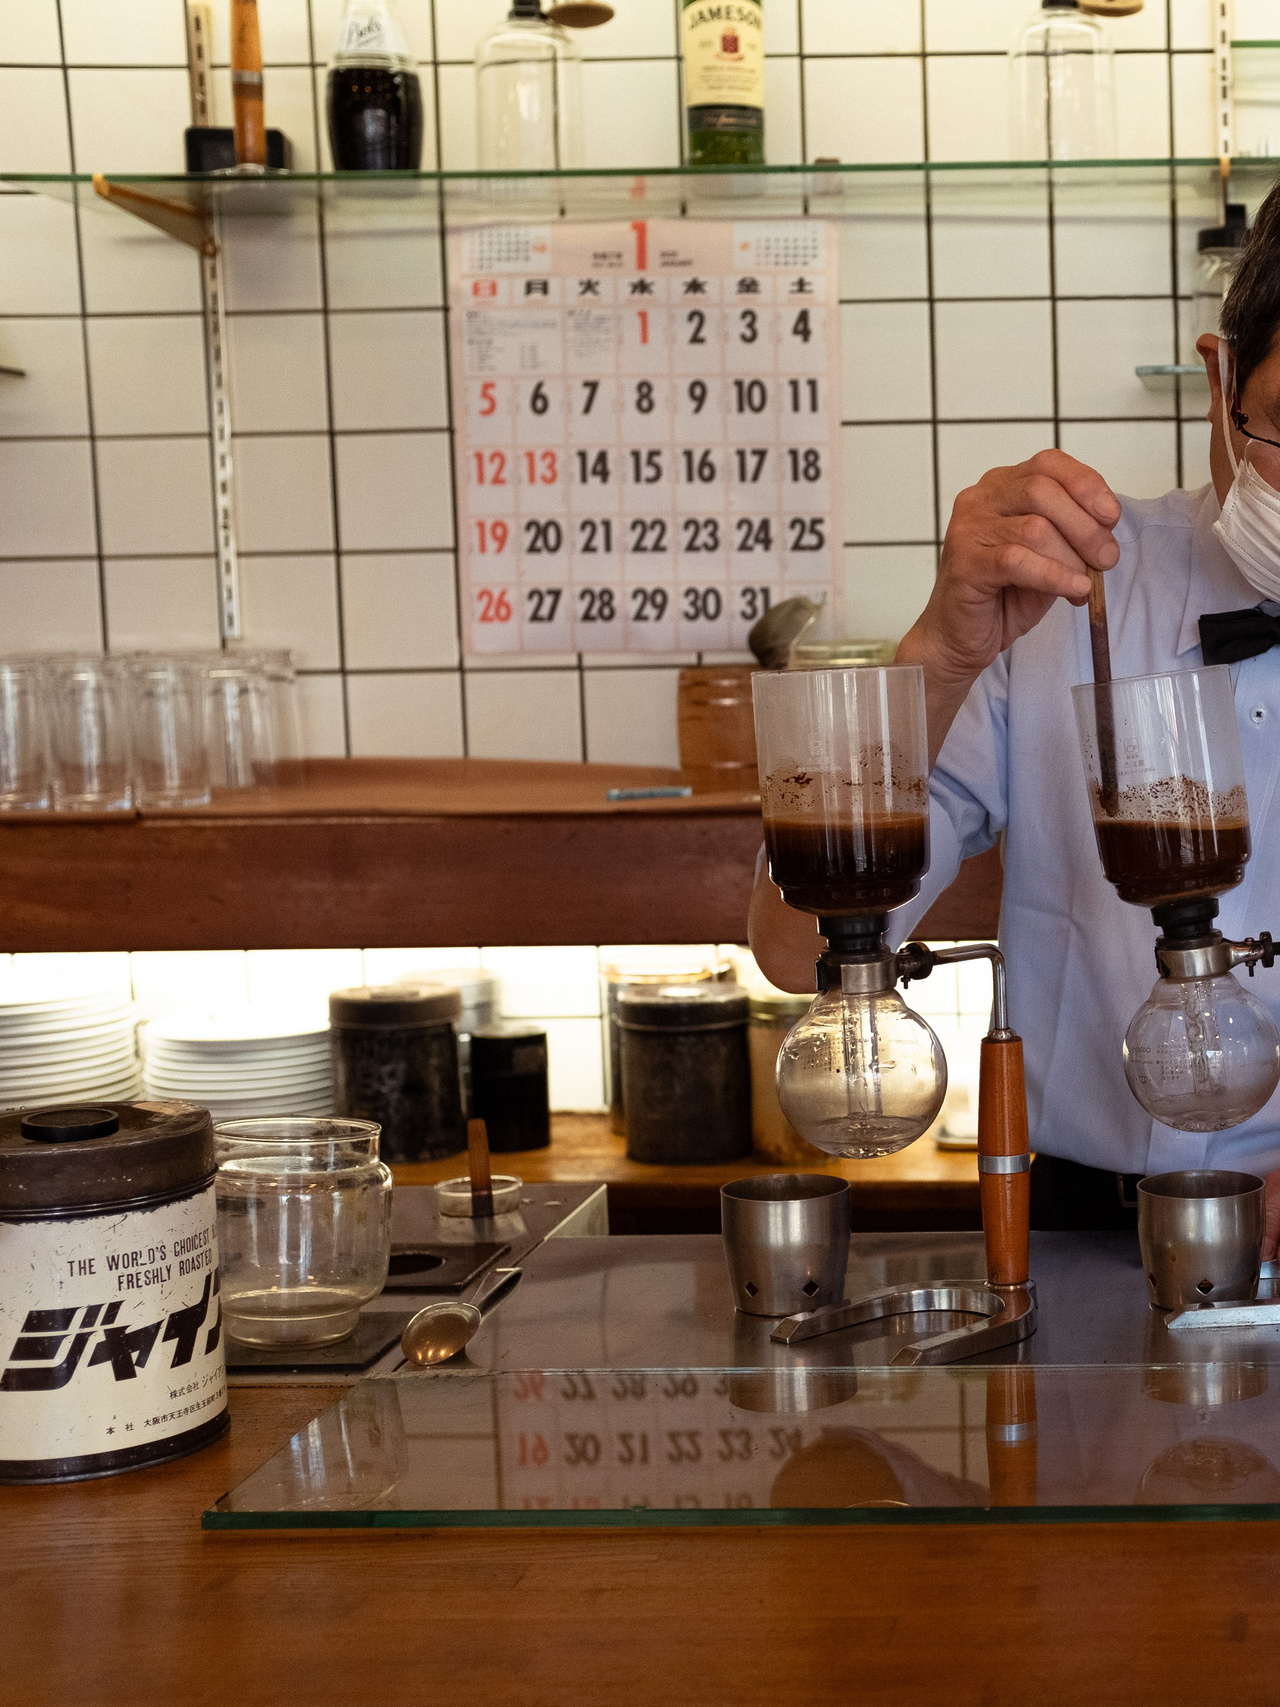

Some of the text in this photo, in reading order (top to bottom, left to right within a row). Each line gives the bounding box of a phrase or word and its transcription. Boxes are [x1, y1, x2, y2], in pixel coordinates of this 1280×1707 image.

[630, 219, 648, 272] 1
[472, 276, 814, 297] 日 月 火 水 木 金 土
[635, 309, 651, 347] 1
[687, 309, 706, 345] 2
[740, 309, 758, 344] 3
[792, 309, 812, 343] 4
[480, 378, 819, 417] 5 6 7 8 9 10 11
[474, 448, 821, 486] 12 13 14 15 16 17 18
[476, 517, 825, 554] 19 20 21 22 23 24 25
[477, 587, 770, 623] 26 27 28 29 30 31
[67, 1258, 97, 1277] THE
[106, 1245, 167, 1272] WORLD'S
[173, 1227, 210, 1258] CHOICEST
[117, 1264, 172, 1292] FRESHLY
[169, 1380, 200, 1400] 株式会社
